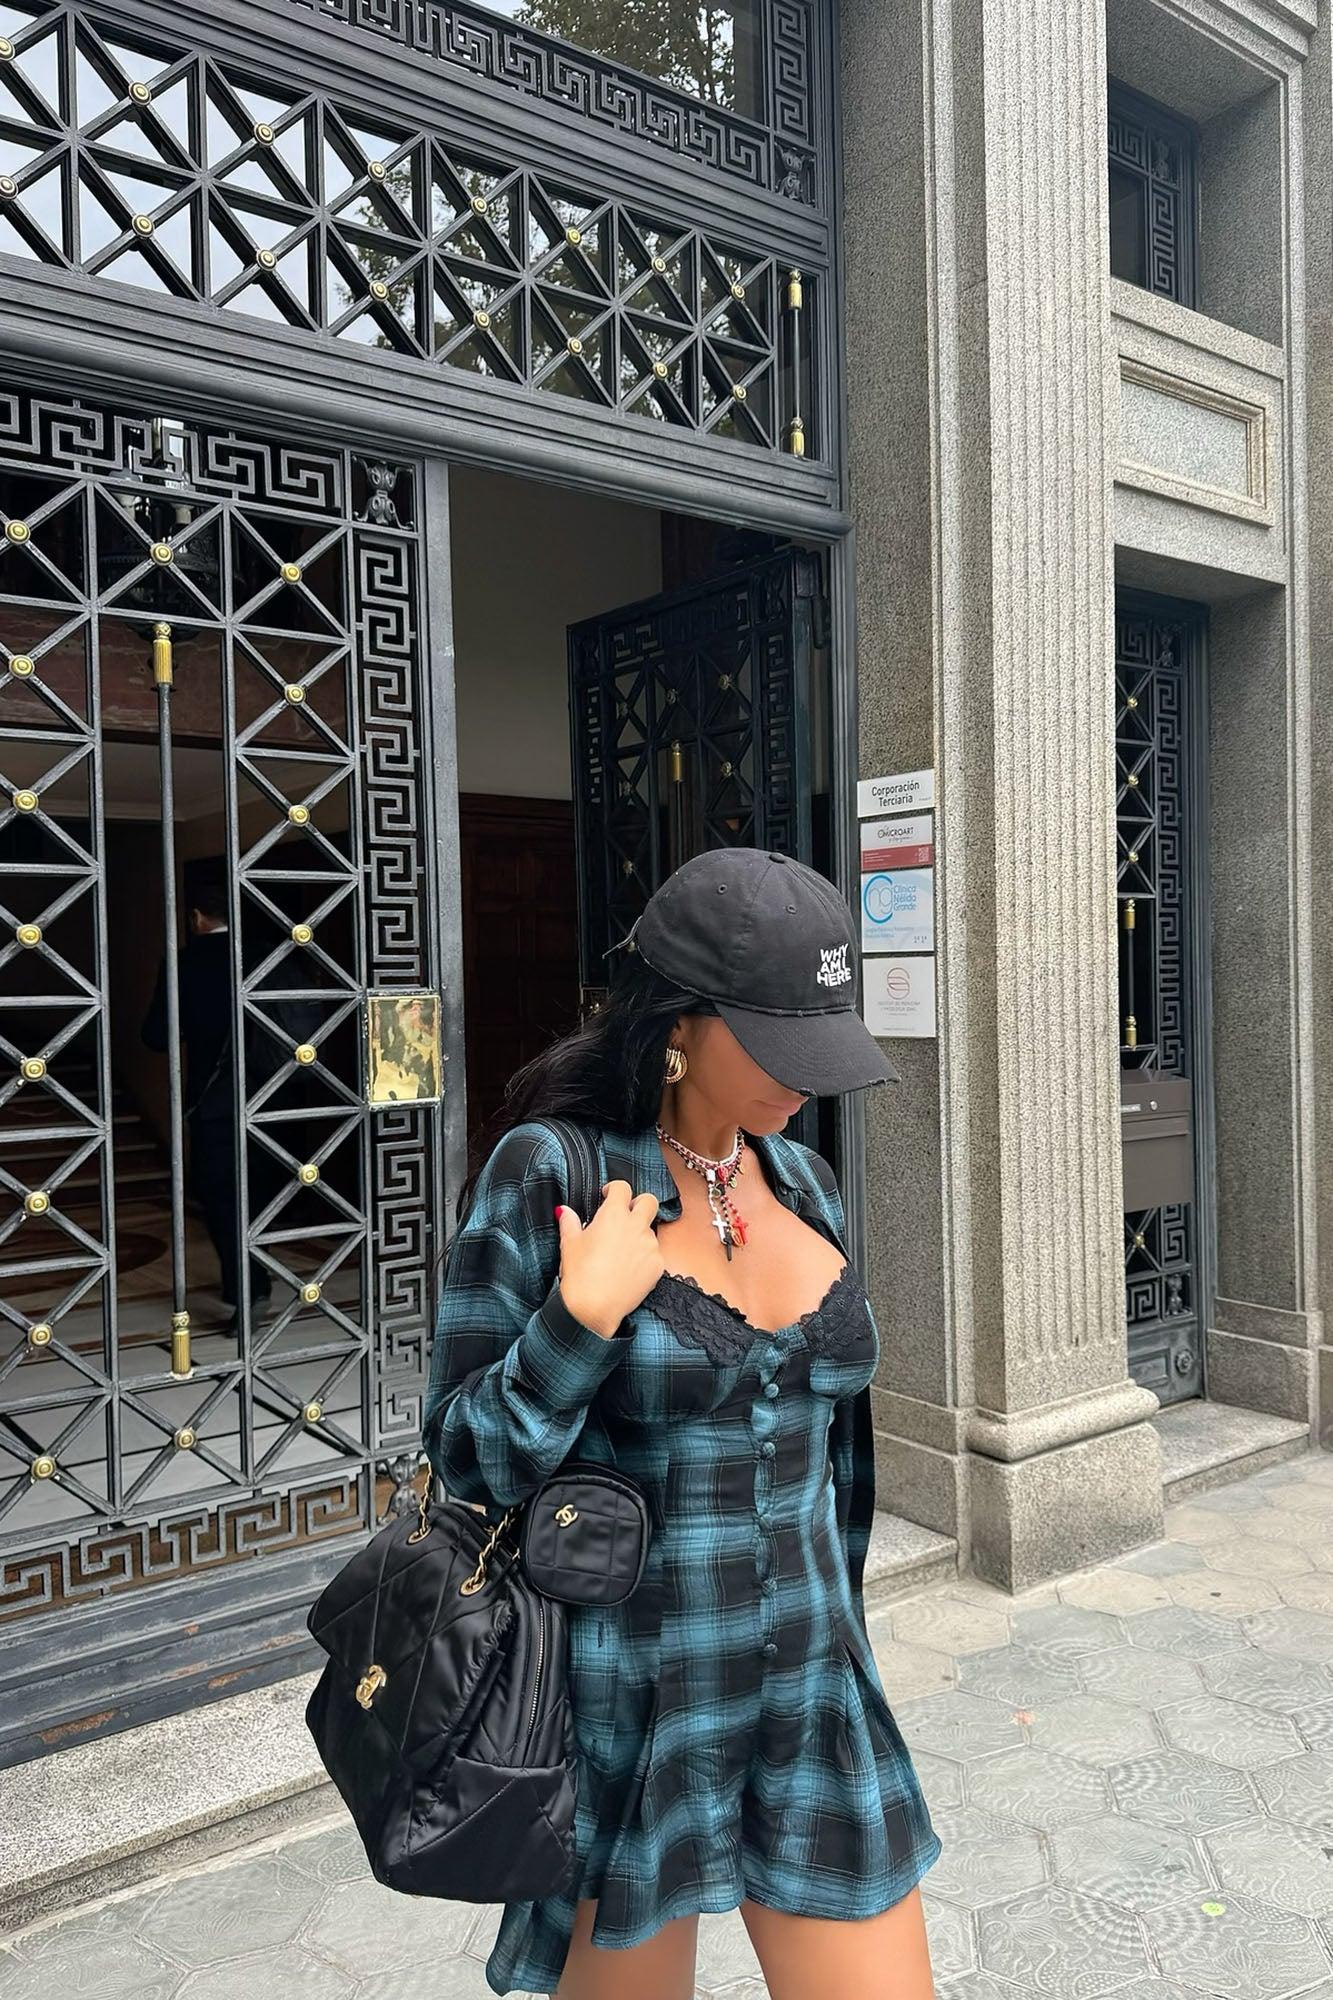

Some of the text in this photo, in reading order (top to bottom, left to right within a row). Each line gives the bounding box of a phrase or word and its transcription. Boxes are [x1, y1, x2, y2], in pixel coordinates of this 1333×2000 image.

[871, 780, 920, 797] Corporación
[879, 794, 913, 807] Terciaria
[820, 943, 849, 963] WHY
[820, 958, 841, 974] AM
[816, 967, 852, 987] HERE
